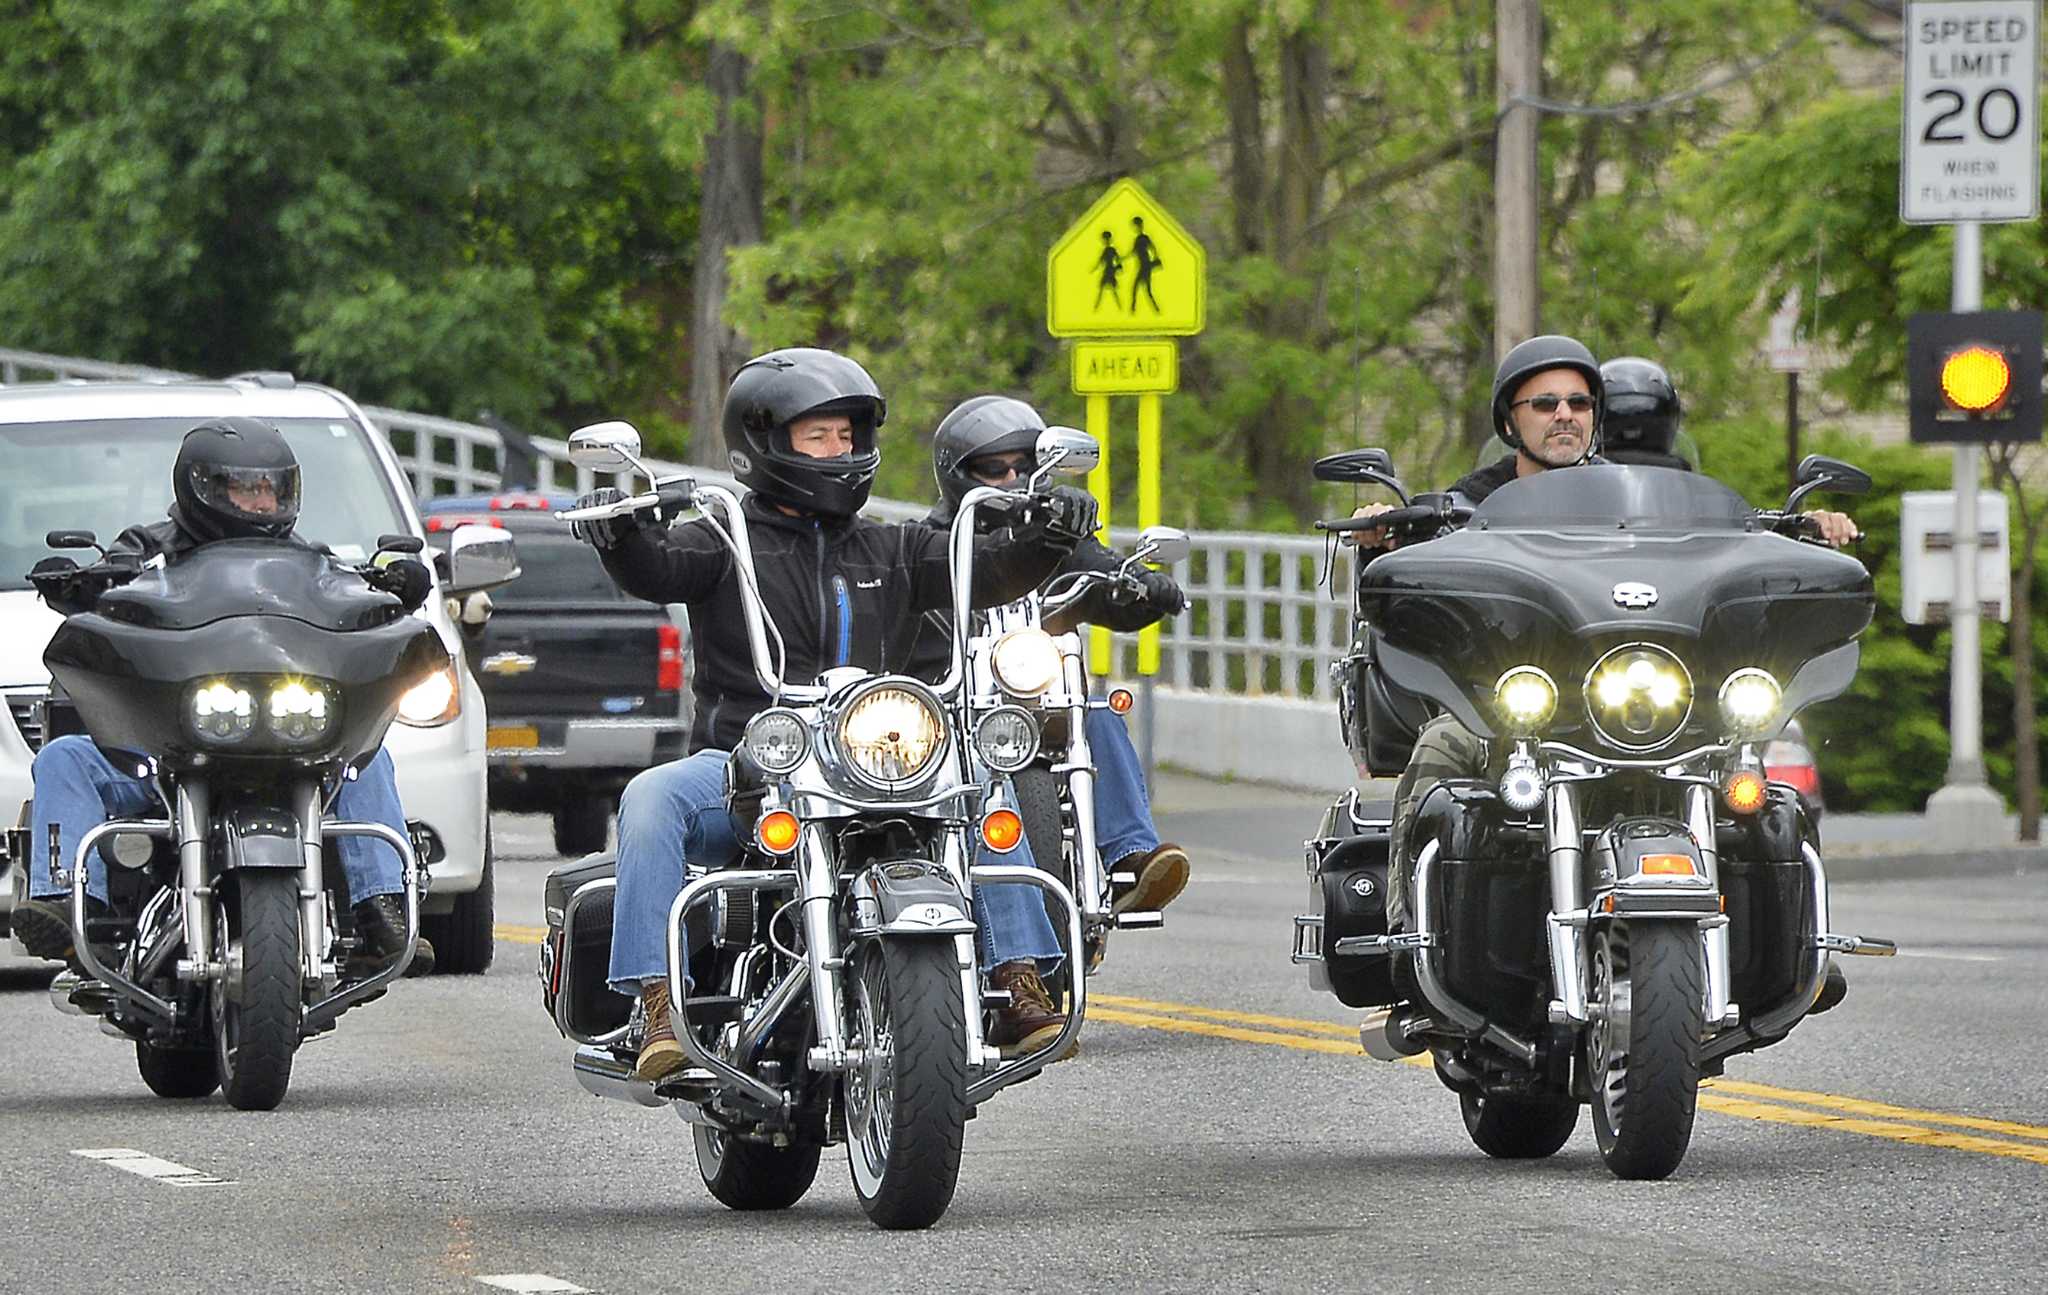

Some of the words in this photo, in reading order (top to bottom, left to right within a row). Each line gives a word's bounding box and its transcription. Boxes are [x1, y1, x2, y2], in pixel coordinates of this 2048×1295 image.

[1920, 18, 2026, 44] SPEED
[1929, 53, 2014, 78] LIMIT
[1922, 87, 2021, 142] 20
[1943, 160, 1998, 176] WHEN
[1921, 184, 2016, 200] FLASHING
[1088, 356, 1160, 378] AHEAD
